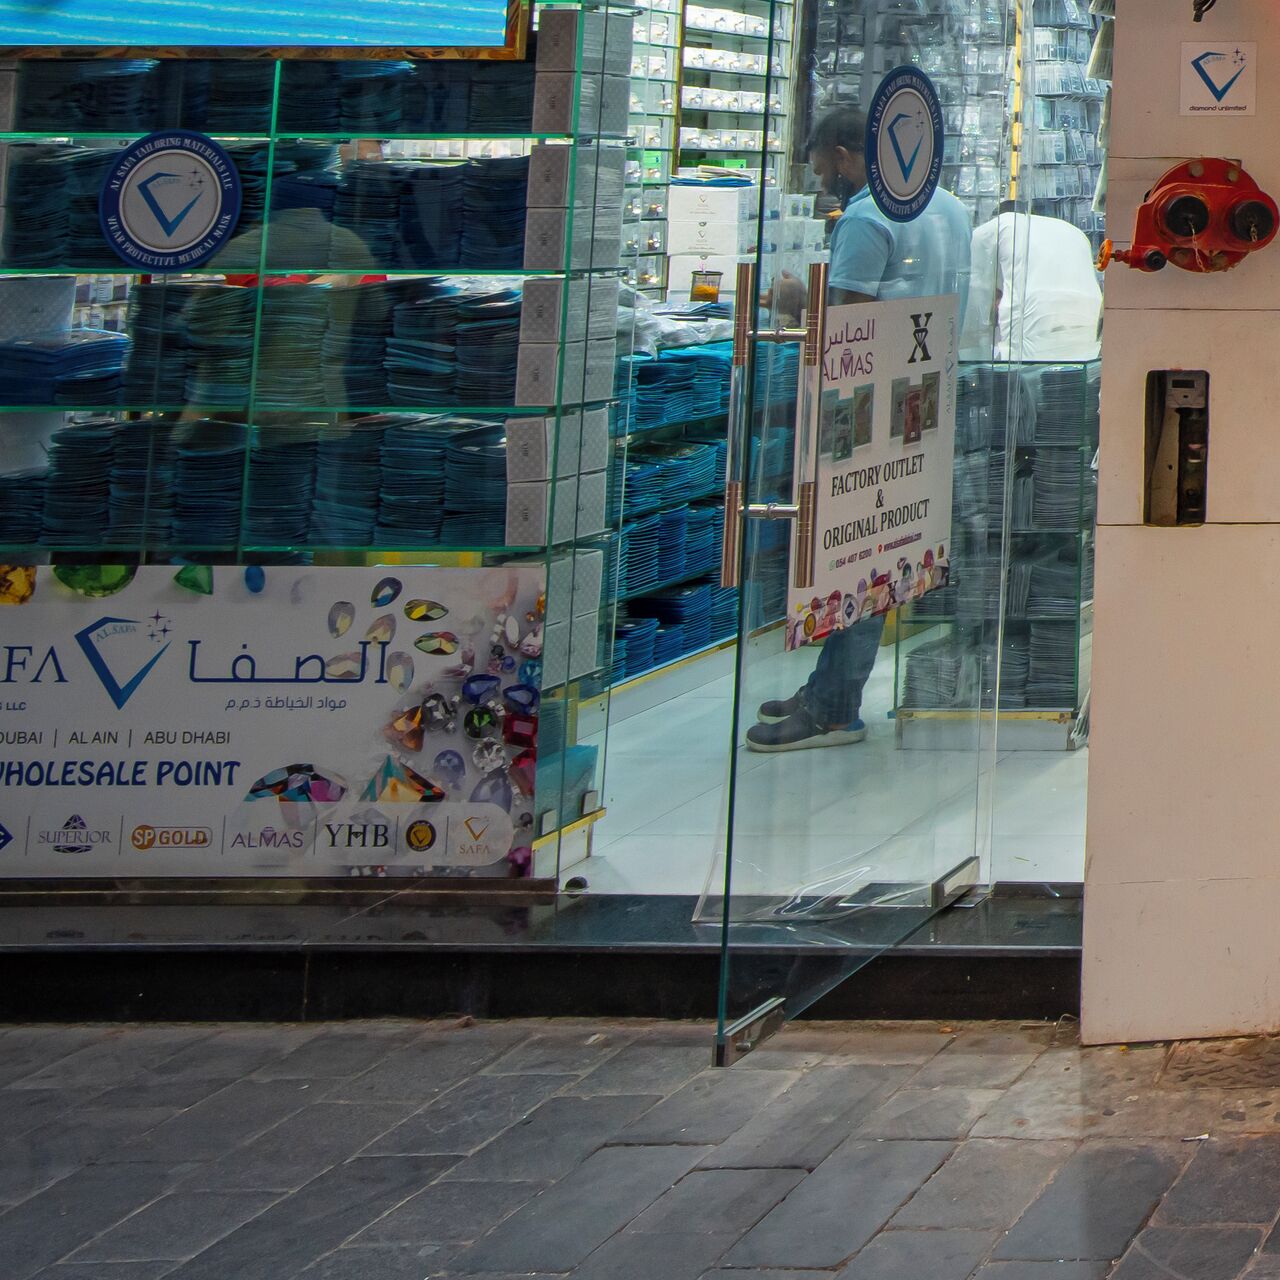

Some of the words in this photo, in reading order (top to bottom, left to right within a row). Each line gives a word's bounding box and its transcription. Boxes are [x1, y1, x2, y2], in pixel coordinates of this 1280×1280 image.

[117, 156, 137, 177] SAFA
[134, 137, 182, 158] TAILORING
[183, 138, 228, 173] MATERIALS
[122, 240, 177, 266] PROTECTIVE
[831, 465, 882, 497] FACTORY
[884, 453, 925, 482] OUTLET
[875, 488, 885, 509] &
[823, 514, 878, 550] ORIGINAL
[880, 498, 930, 532] PRODUCT
[187, 639, 391, 684] الصفا
[6, 701, 27, 711] LLC
[265, 696, 313, 712] الخياطة
[316, 696, 347, 712] مواد
[144, 731, 177, 744] ABU
[182, 731, 230, 744] DHABI
[156, 760, 241, 786] POINT
[38, 830, 112, 845] SUPERIOR
[133, 829, 155, 846] SP
[158, 829, 208, 846] GOLD
[231, 827, 304, 849] ALMAS
[325, 823, 389, 848] YHB
